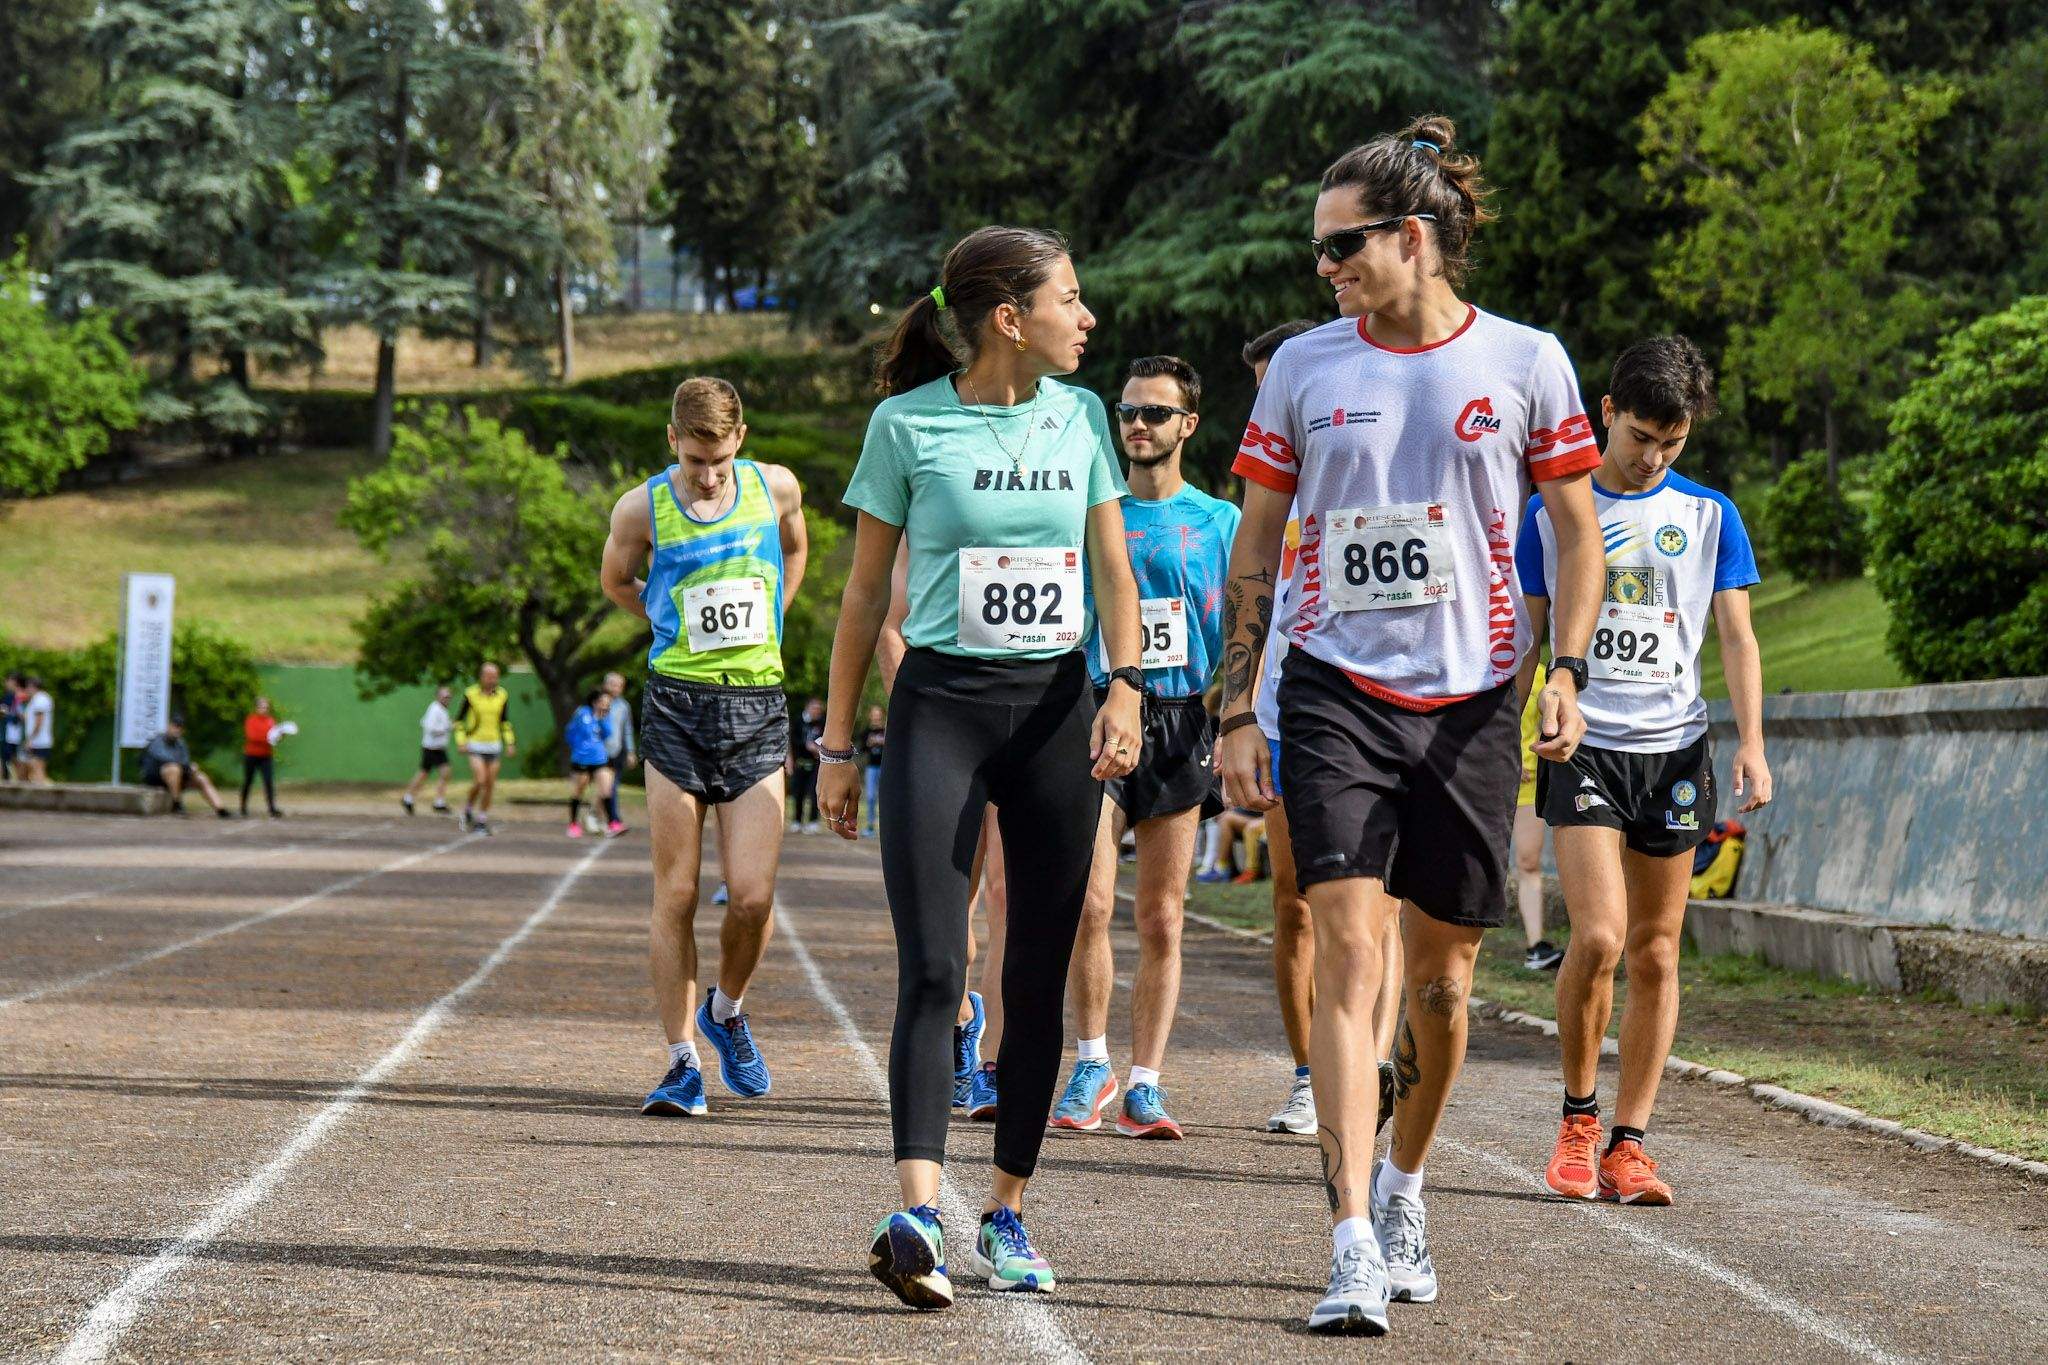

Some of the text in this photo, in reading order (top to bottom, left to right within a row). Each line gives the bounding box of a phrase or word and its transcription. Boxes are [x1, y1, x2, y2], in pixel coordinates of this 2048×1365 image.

[1471, 415, 1501, 430] FNA
[973, 469, 1074, 491] BIKILA
[1344, 538, 1429, 586] 866
[1386, 583, 1448, 602] rasán 2023
[982, 582, 1062, 625] 882
[701, 601, 754, 634] 867
[1022, 631, 1077, 643] rasán 2023
[1593, 628, 1659, 665] 892
[1167, 654, 1183, 662] 2023
[1651, 670, 1670, 679] 2023
